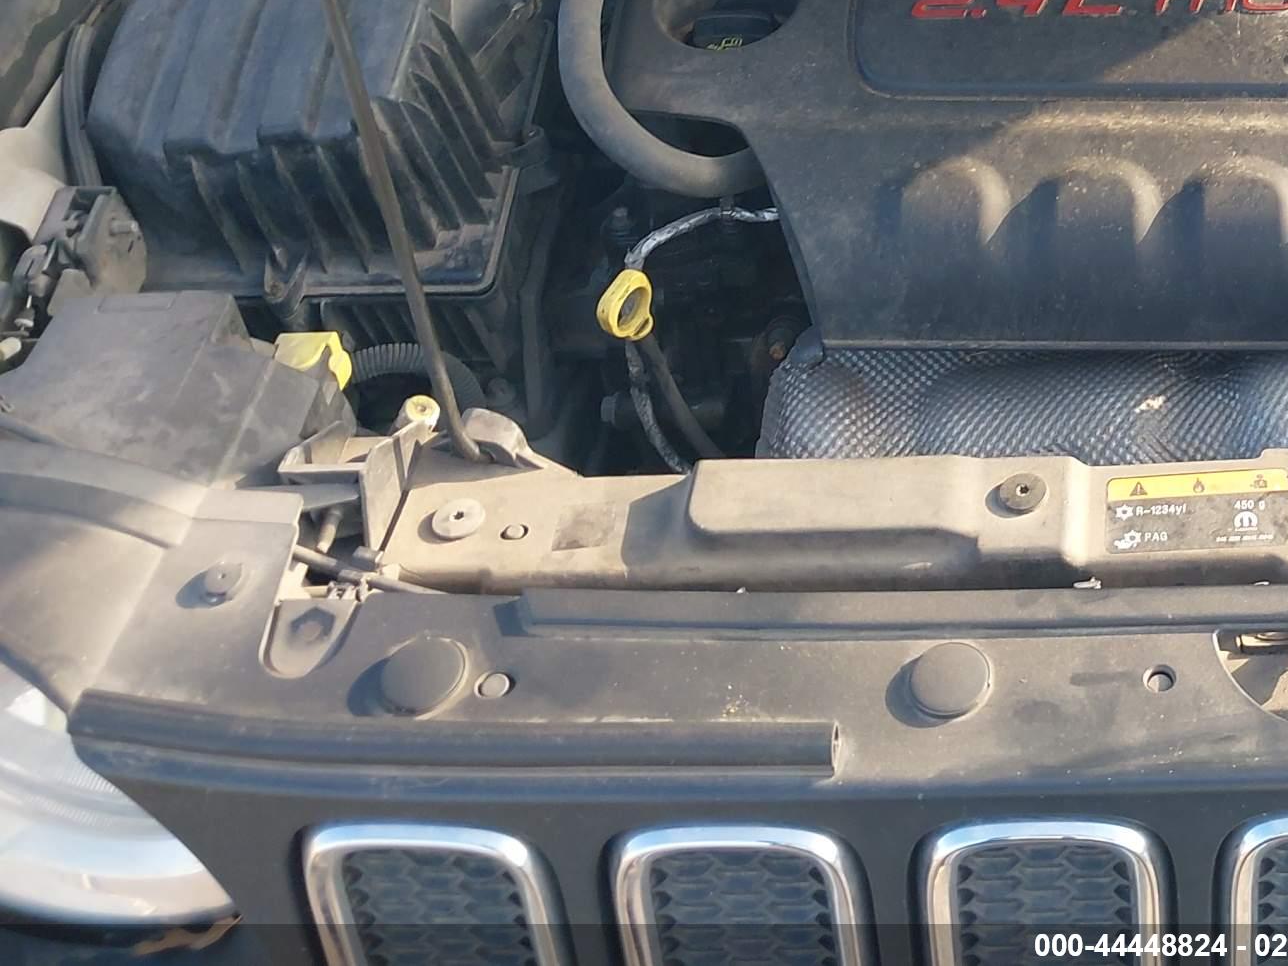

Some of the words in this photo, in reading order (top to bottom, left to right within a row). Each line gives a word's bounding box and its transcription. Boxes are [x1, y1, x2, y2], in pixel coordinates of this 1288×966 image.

[1234, 500, 1255, 510] 450
[1259, 500, 1265, 511] g
[1144, 531, 1168, 542] PAG
